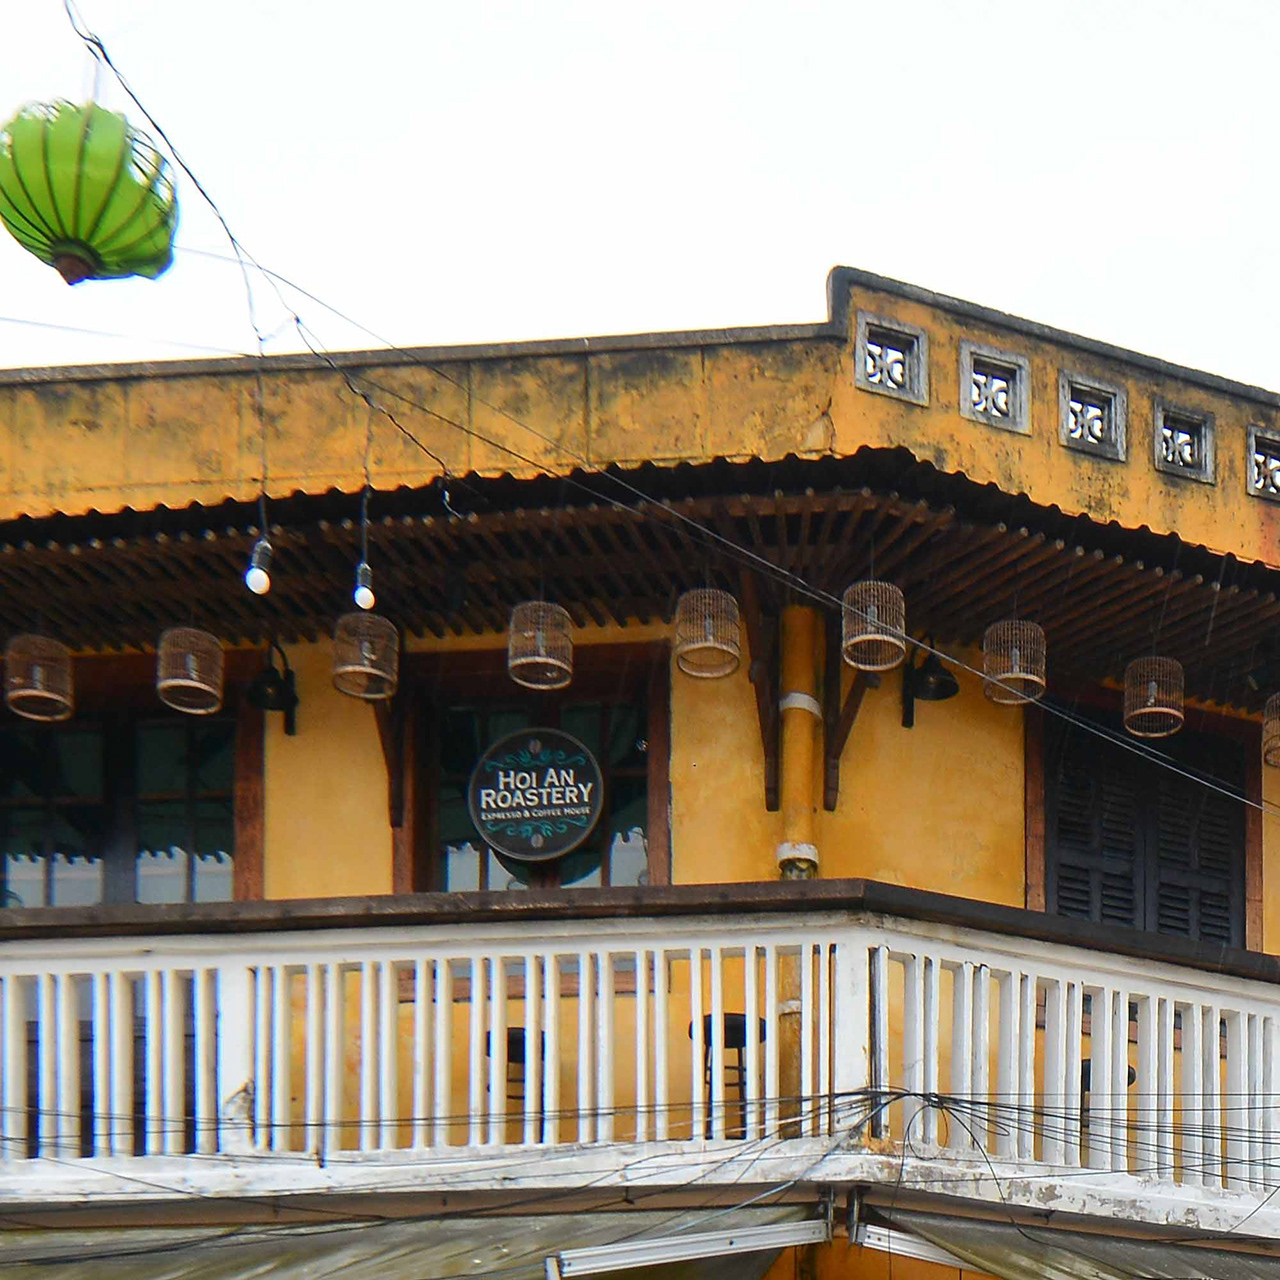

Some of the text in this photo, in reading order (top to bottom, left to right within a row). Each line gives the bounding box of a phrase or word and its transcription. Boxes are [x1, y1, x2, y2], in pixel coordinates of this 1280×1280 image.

[498, 768, 575, 789] HOI AN
[481, 782, 593, 809] ROASTERY
[532, 808, 562, 817] COFFEE
[564, 806, 591, 816] HOUSE
